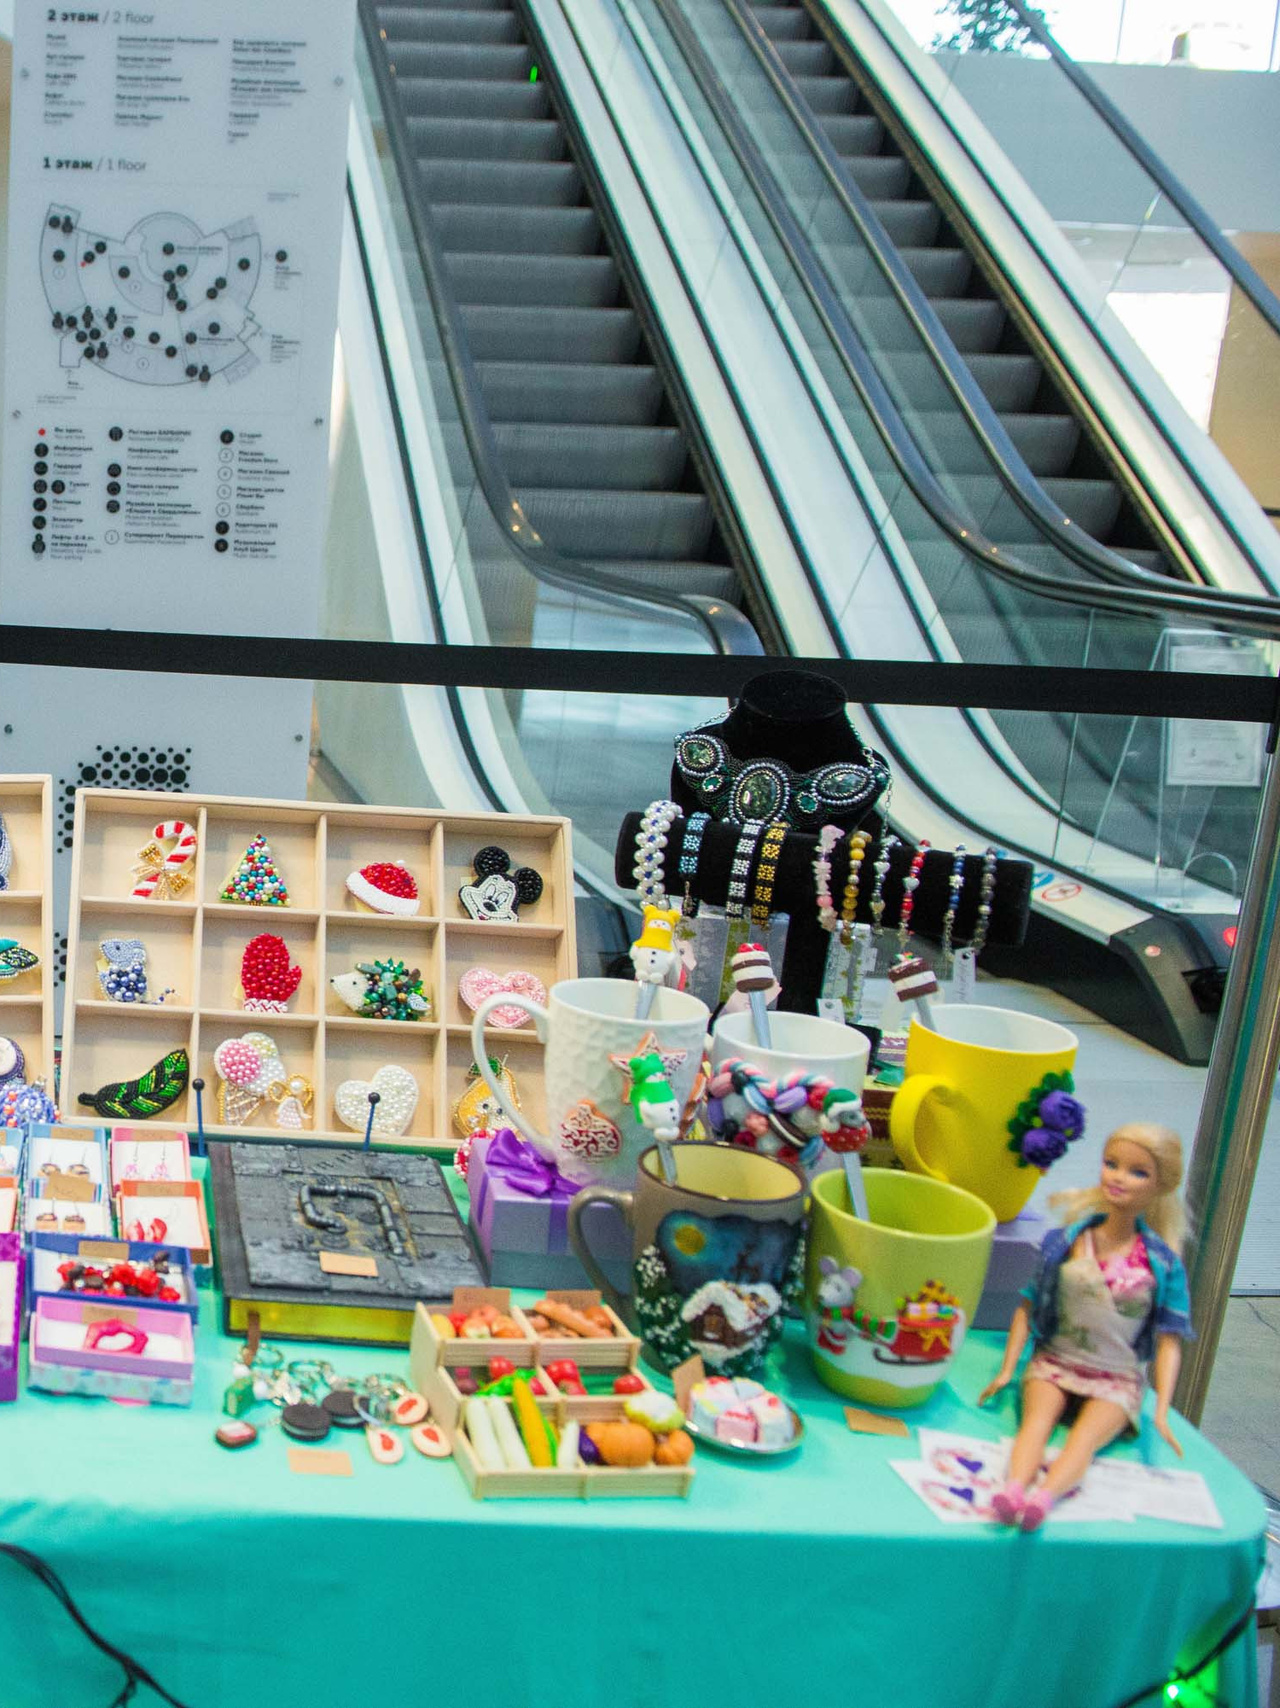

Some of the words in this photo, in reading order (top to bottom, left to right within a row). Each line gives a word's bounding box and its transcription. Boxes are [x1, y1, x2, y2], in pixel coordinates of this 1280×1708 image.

[47, 9, 56, 21] 2
[61, 12, 99, 21] этаж
[113, 10, 121, 23] 2
[125, 9, 154, 23] floor
[43, 157, 51, 169] 1
[56, 159, 93, 169] этаж
[118, 158, 147, 171] floor
